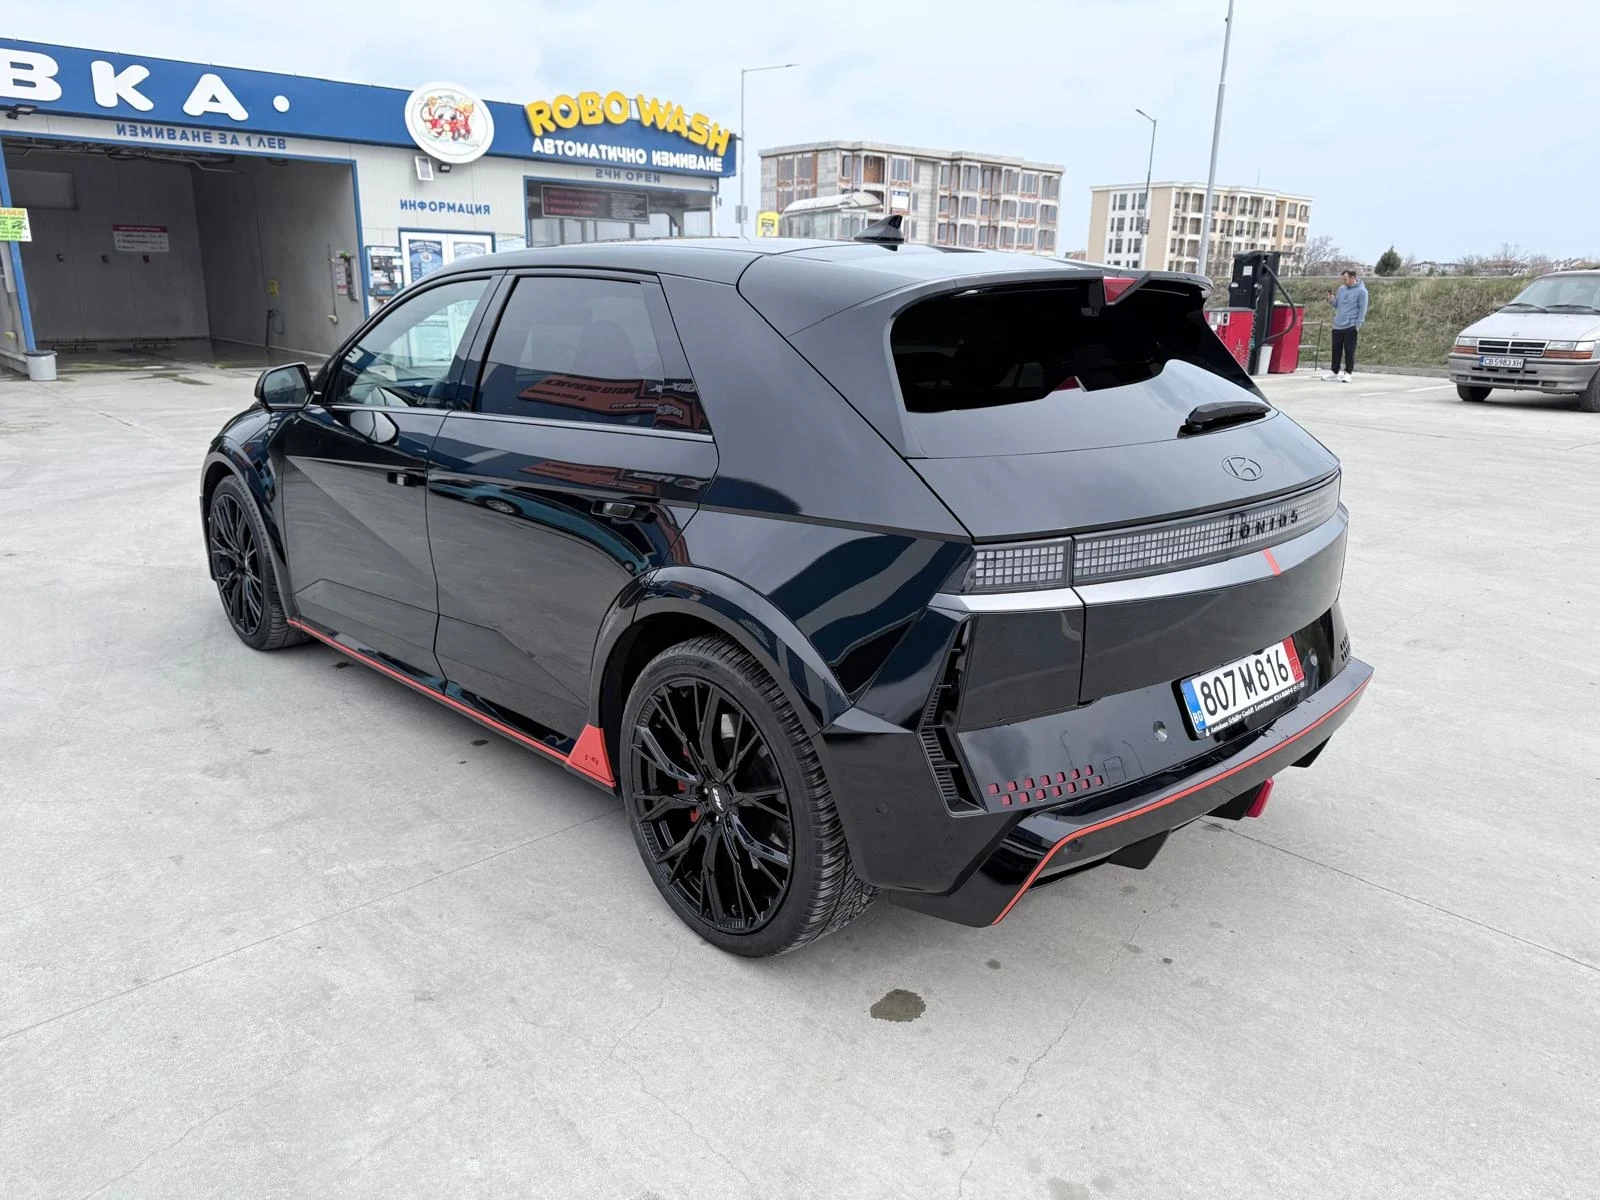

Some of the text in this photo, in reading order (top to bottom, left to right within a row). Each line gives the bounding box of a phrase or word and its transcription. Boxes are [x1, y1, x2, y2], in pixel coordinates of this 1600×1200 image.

[115, 123, 287, 150] ИЗМИВАНЕ ЗА 1 ЛЕВ
[526, 91, 730, 156] ROBO WASH
[532, 137, 723, 172] АВТОМАТИЧНО ИЗМИВАНЕ
[595, 168, 661, 183] 24H OPEN
[400, 199, 491, 215] ИНФОРМАЦИЯ
